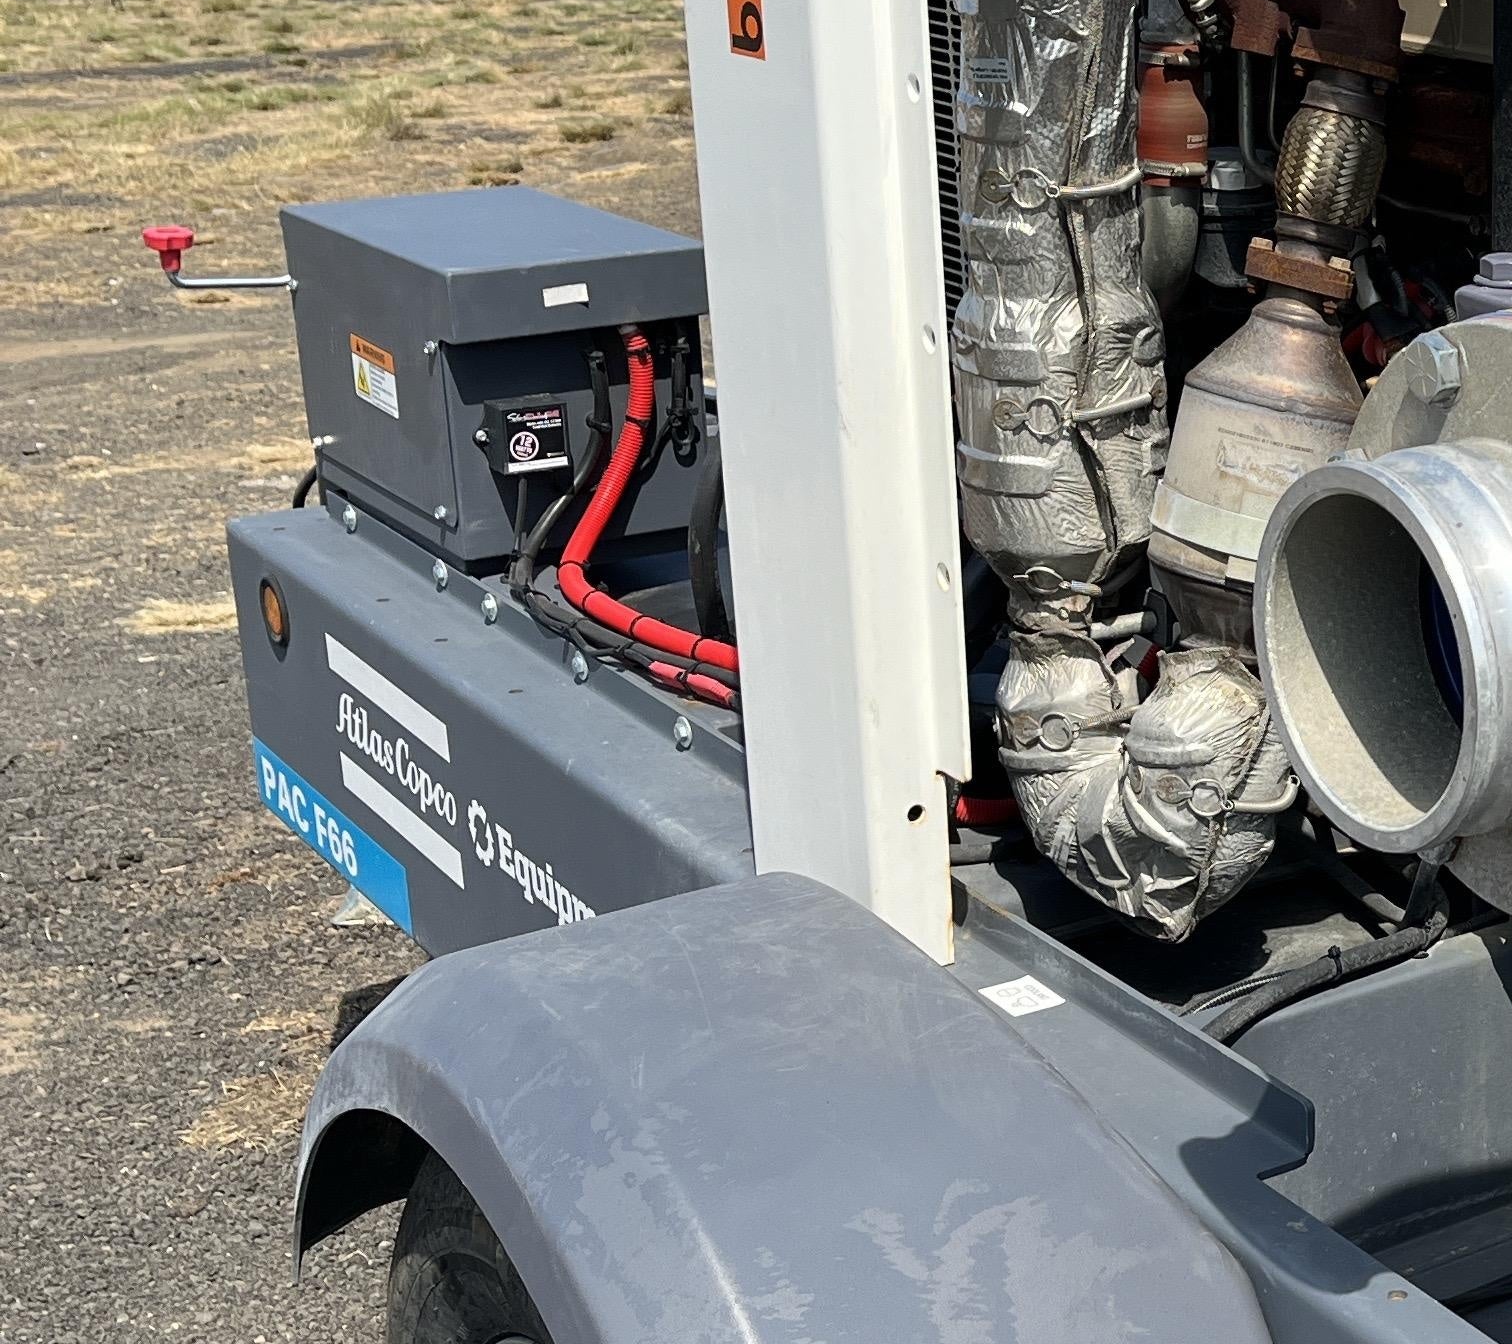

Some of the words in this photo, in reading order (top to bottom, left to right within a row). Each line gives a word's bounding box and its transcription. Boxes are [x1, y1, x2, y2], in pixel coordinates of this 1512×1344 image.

[261, 755, 309, 833] PAC
[313, 801, 358, 878] F66
[336, 692, 394, 776] Atlas
[395, 737, 457, 827] Copco
